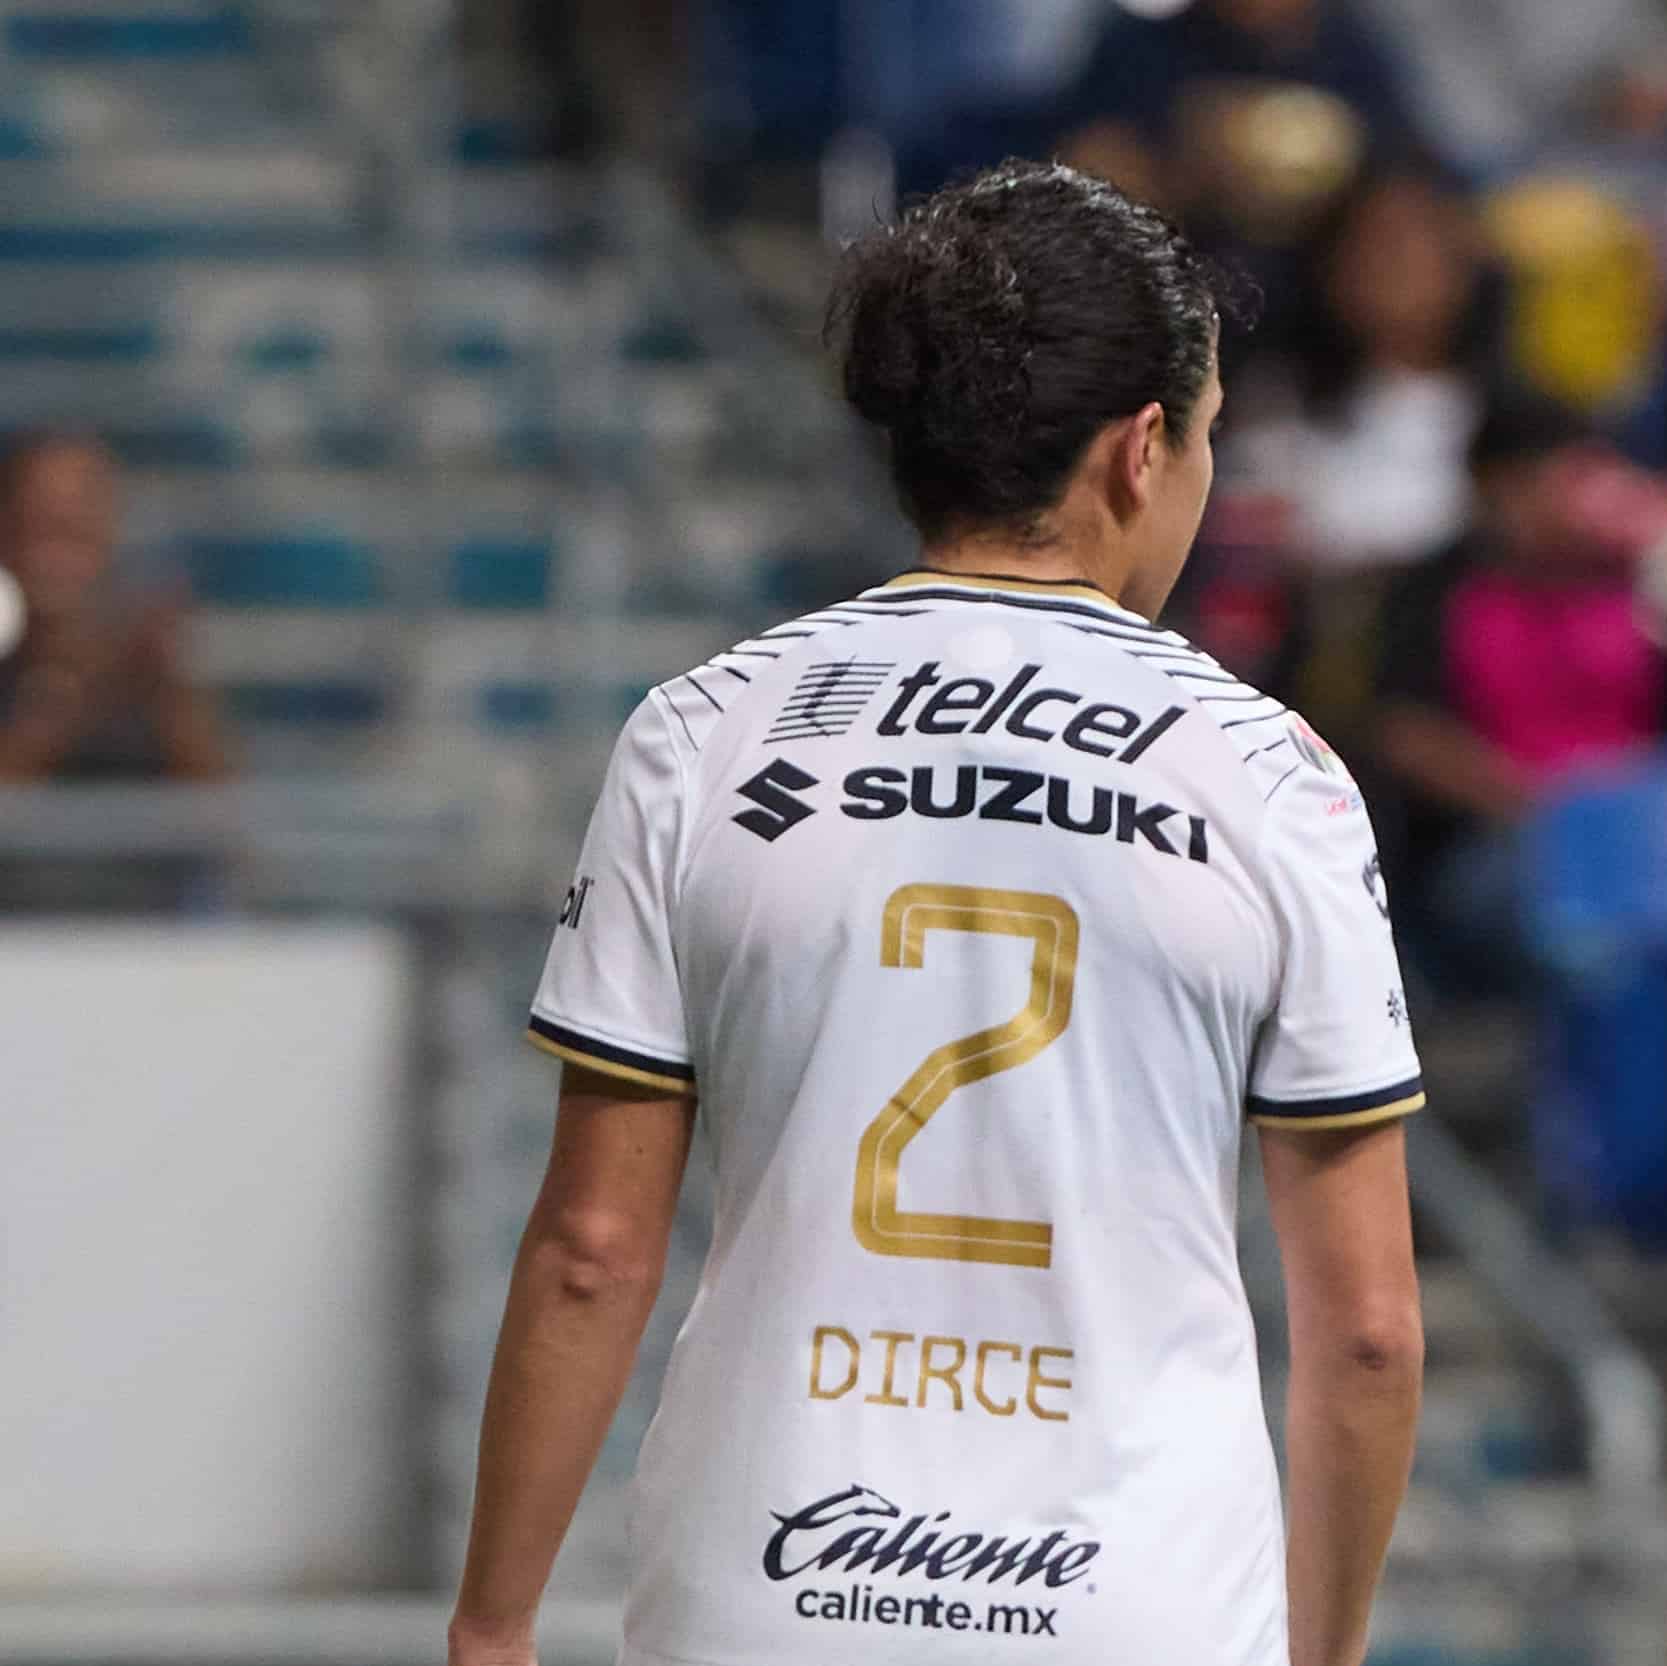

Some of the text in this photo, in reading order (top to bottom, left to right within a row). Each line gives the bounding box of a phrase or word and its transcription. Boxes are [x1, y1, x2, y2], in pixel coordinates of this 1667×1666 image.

[875, 659, 1189, 765] telcel
[839, 765, 1209, 864] SUZUKI
[851, 883, 1080, 1269] 2
[808, 1325, 1076, 1422] DIRCE
[763, 1483, 1101, 1588] Caliente
[795, 1584, 1058, 1637] caliente.mx
